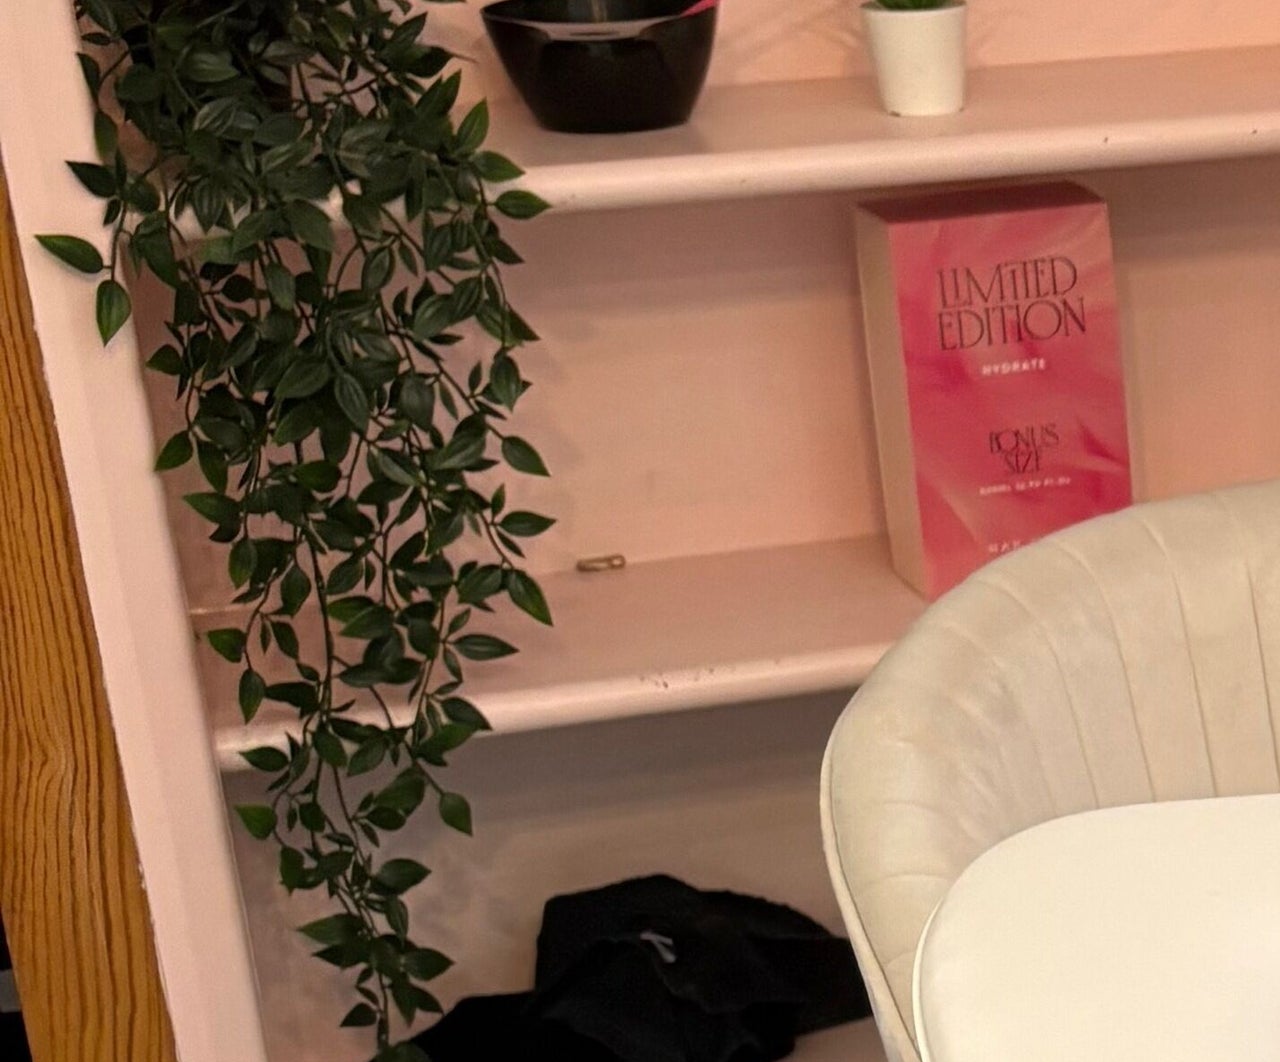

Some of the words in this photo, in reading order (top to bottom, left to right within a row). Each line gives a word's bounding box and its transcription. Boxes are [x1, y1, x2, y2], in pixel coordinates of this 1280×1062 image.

[937, 256, 1078, 309] LIMITED
[938, 297, 1087, 350] EDITION
[981, 357, 1046, 377] HYDRATE
